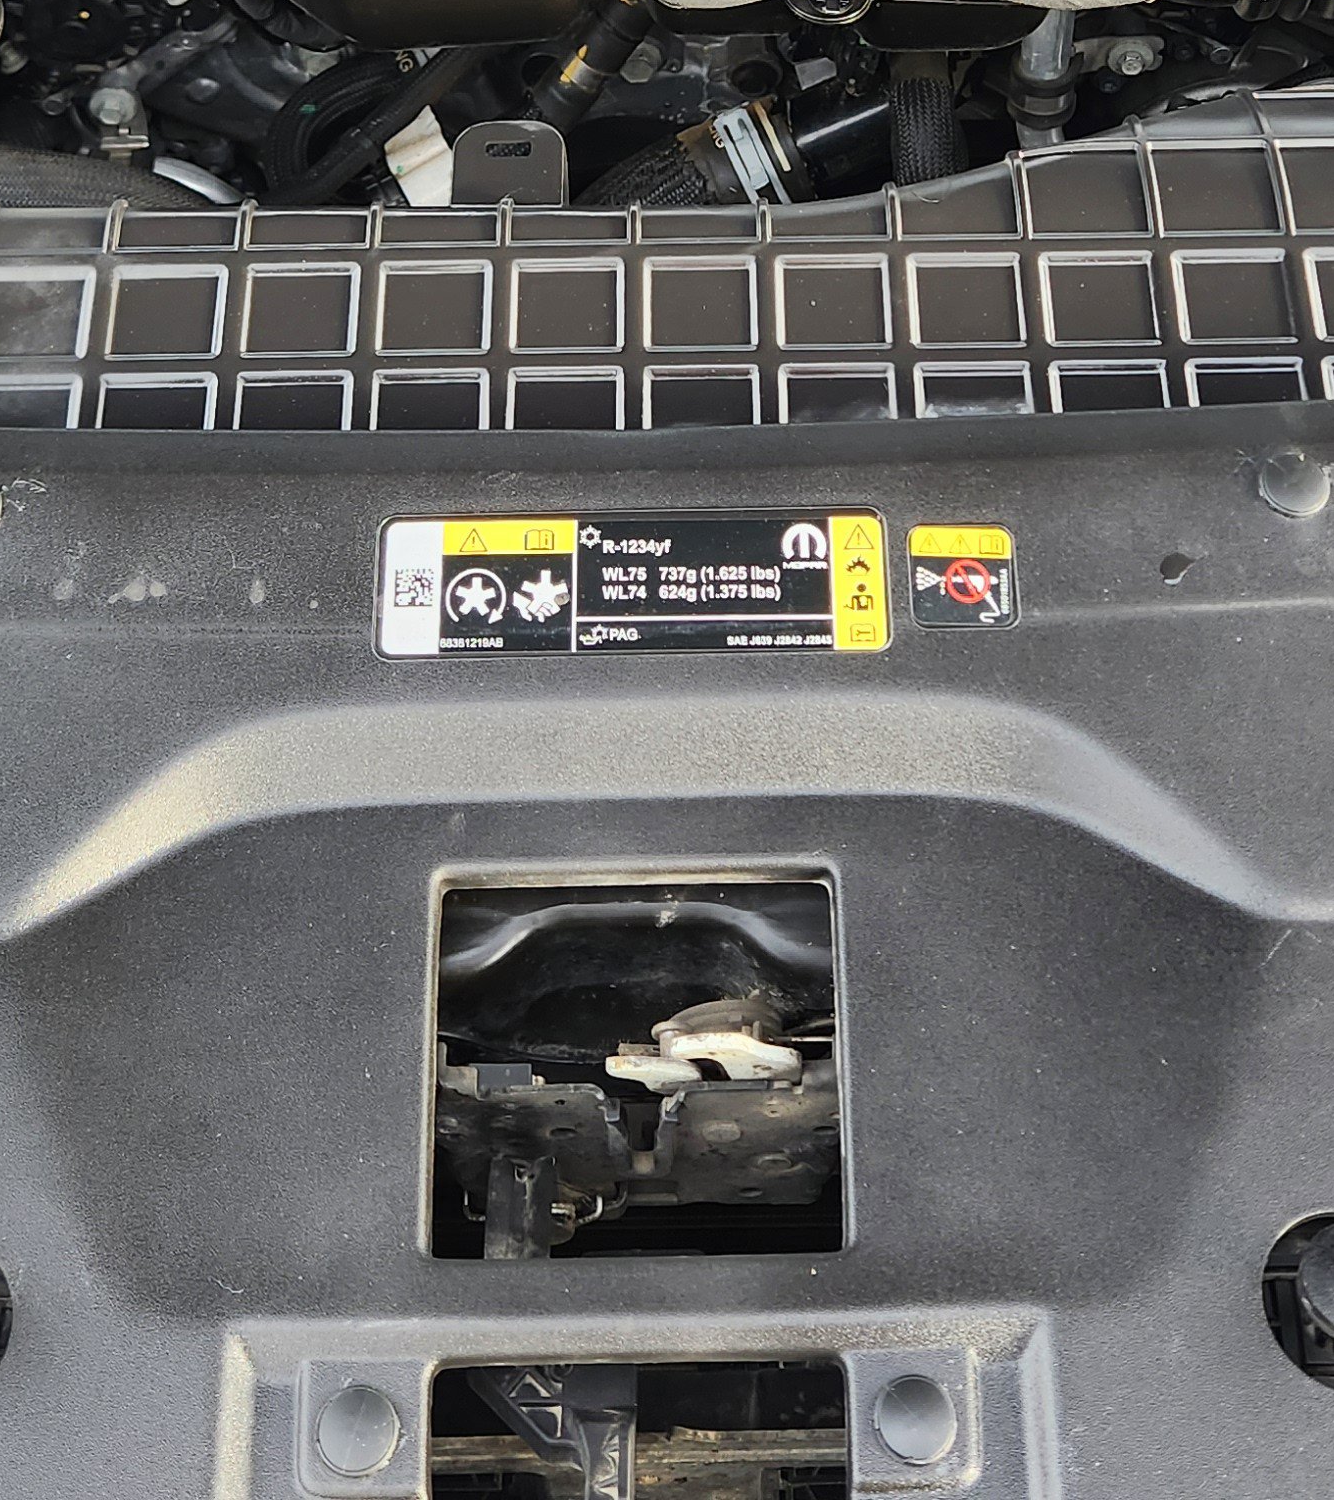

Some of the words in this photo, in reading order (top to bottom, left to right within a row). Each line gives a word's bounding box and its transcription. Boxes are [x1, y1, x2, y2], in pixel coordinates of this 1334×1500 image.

[602, 539, 671, 557] R-1234yf
[602, 567, 647, 581] WL75
[659, 566, 697, 583] 737g
[700, 566, 748, 583] (1.625
[750, 565, 781, 583] lbs)
[602, 585, 647, 600] WL74
[659, 585, 697, 602] 624g
[700, 584, 748, 602] (1.375
[750, 583, 781, 602] lbs)
[726, 635, 748, 646] SAE
